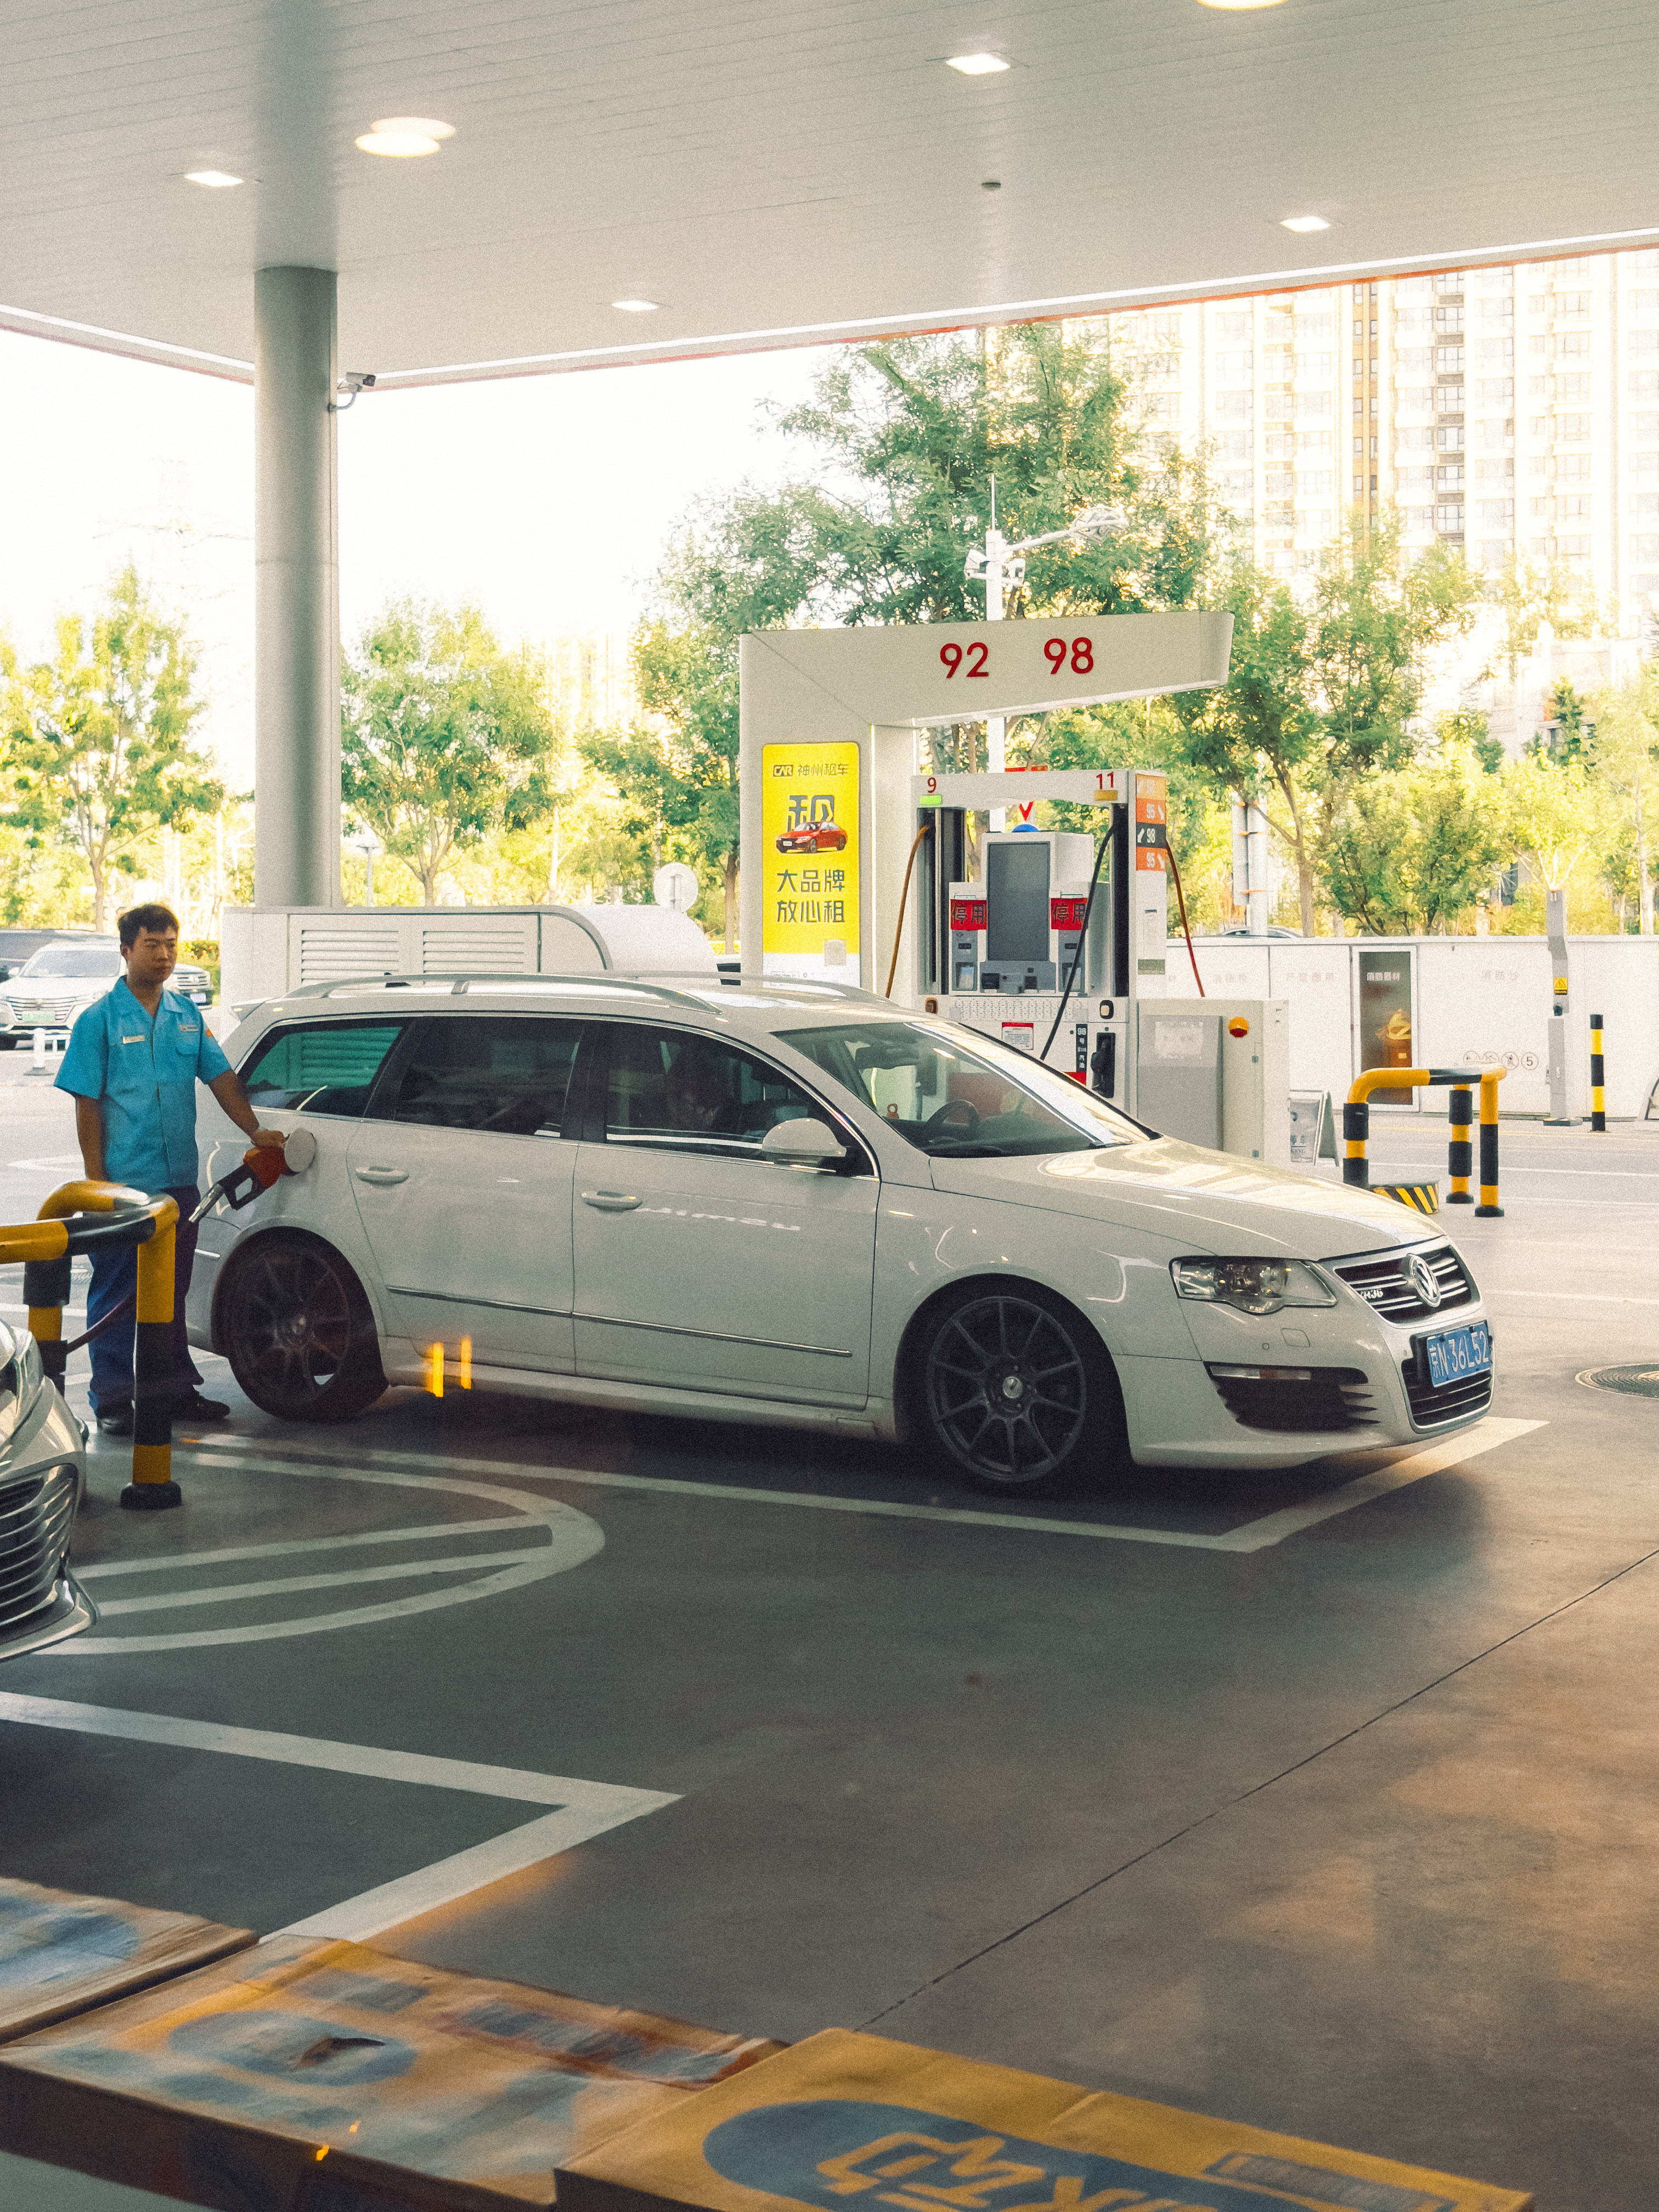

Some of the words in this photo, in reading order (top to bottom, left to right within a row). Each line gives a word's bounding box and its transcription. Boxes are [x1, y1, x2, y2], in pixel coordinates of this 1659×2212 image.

[940, 642, 989, 679] 92
[1044, 637, 1094, 674] 98
[774, 765, 793, 777] CAR
[798, 764, 848, 776] 神州租车
[927, 777, 936, 793] 9
[1096, 772, 1114, 790] 11
[1146, 803, 1156, 819] 95
[1147, 828, 1156, 844] 98
[1146, 852, 1156, 868] 95
[777, 870, 845, 892] 大品牌
[777, 900, 845, 923] 放心租
[951, 903, 984, 924] 停用
[1052, 902, 1087, 924] 停用
